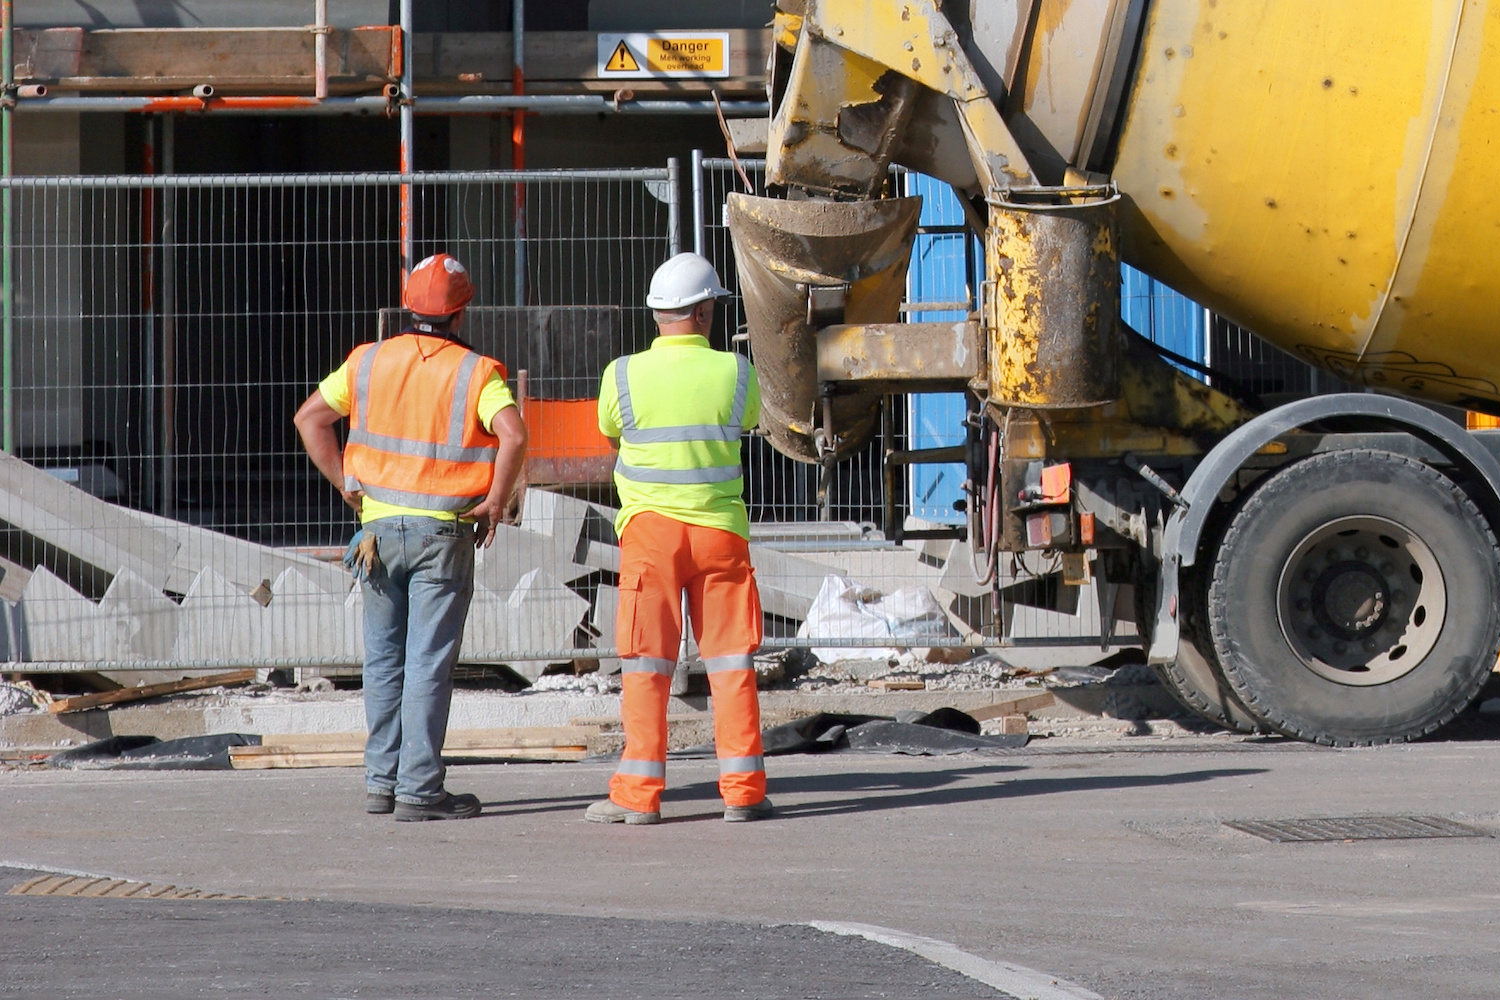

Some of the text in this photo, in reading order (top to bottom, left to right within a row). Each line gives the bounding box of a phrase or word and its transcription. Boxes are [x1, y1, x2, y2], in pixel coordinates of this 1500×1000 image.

[662, 40, 709, 53] Danger
[660, 54, 711, 62] Men working
